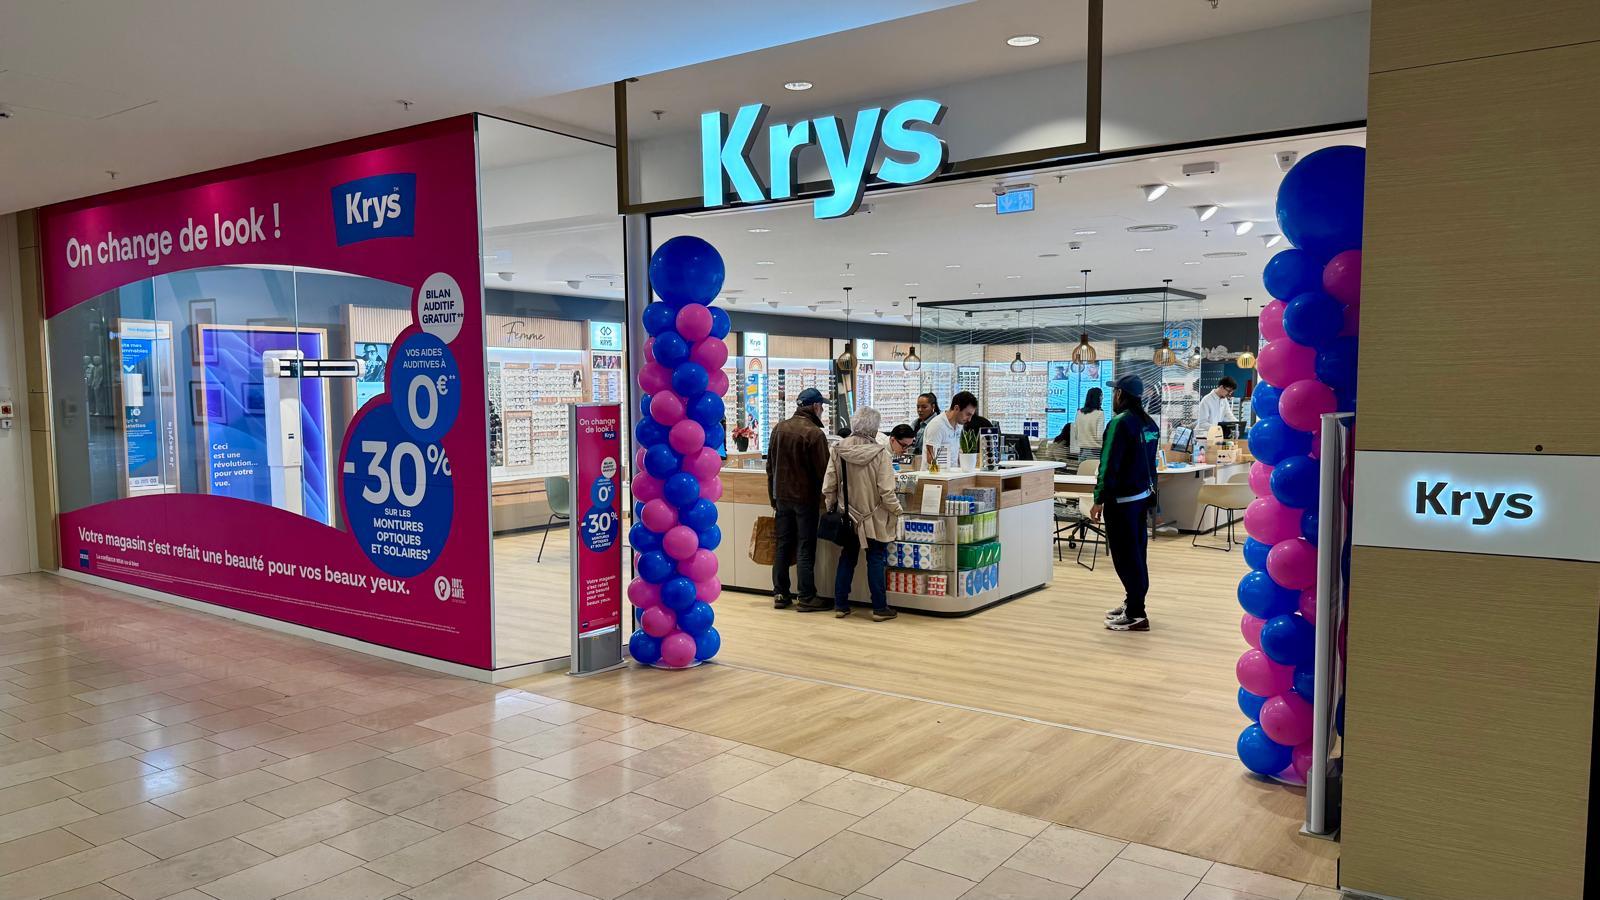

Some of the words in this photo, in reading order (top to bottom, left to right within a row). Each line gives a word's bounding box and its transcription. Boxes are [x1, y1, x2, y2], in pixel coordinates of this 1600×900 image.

[701, 100, 947, 219] Krys
[345, 191, 402, 229] Krys
[66, 237, 93, 268] On
[97, 231, 173, 266] change
[179, 217, 208, 252] de
[214, 206, 267, 248] look
[273, 202, 281, 239] !
[425, 288, 451, 299] BILAN
[423, 301, 455, 311] AUDITIF
[501, 320, 546, 343] Femme
[405, 348, 420, 357] VOS
[420, 348, 443, 357] AIDES
[402, 360, 440, 369] AUDITIVES
[440, 358, 447, 369] À
[579, 418, 590, 426] On
[591, 418, 616, 427] change
[595, 425, 609, 433] look
[213, 460, 259, 468] révolution...
[214, 470, 232, 479] pour
[343, 440, 452, 508] -30%
[1416, 481, 1533, 525] Krys
[384, 508, 398, 517] SUR
[398, 509, 411, 518] LES
[373, 517, 424, 533] MONTURES
[376, 531, 421, 546] OPTIQUES
[371, 543, 382, 554] ET
[78, 526, 104, 544] Votre
[105, 534, 147, 552] magasin
[172, 544, 200, 561] refait
[202, 550, 223, 565] une
[225, 550, 264, 571] beauté
[268, 560, 297, 576] pour
[299, 565, 321, 581] vos
[324, 565, 367, 588] beaux
[370, 575, 410, 595] yeux.
